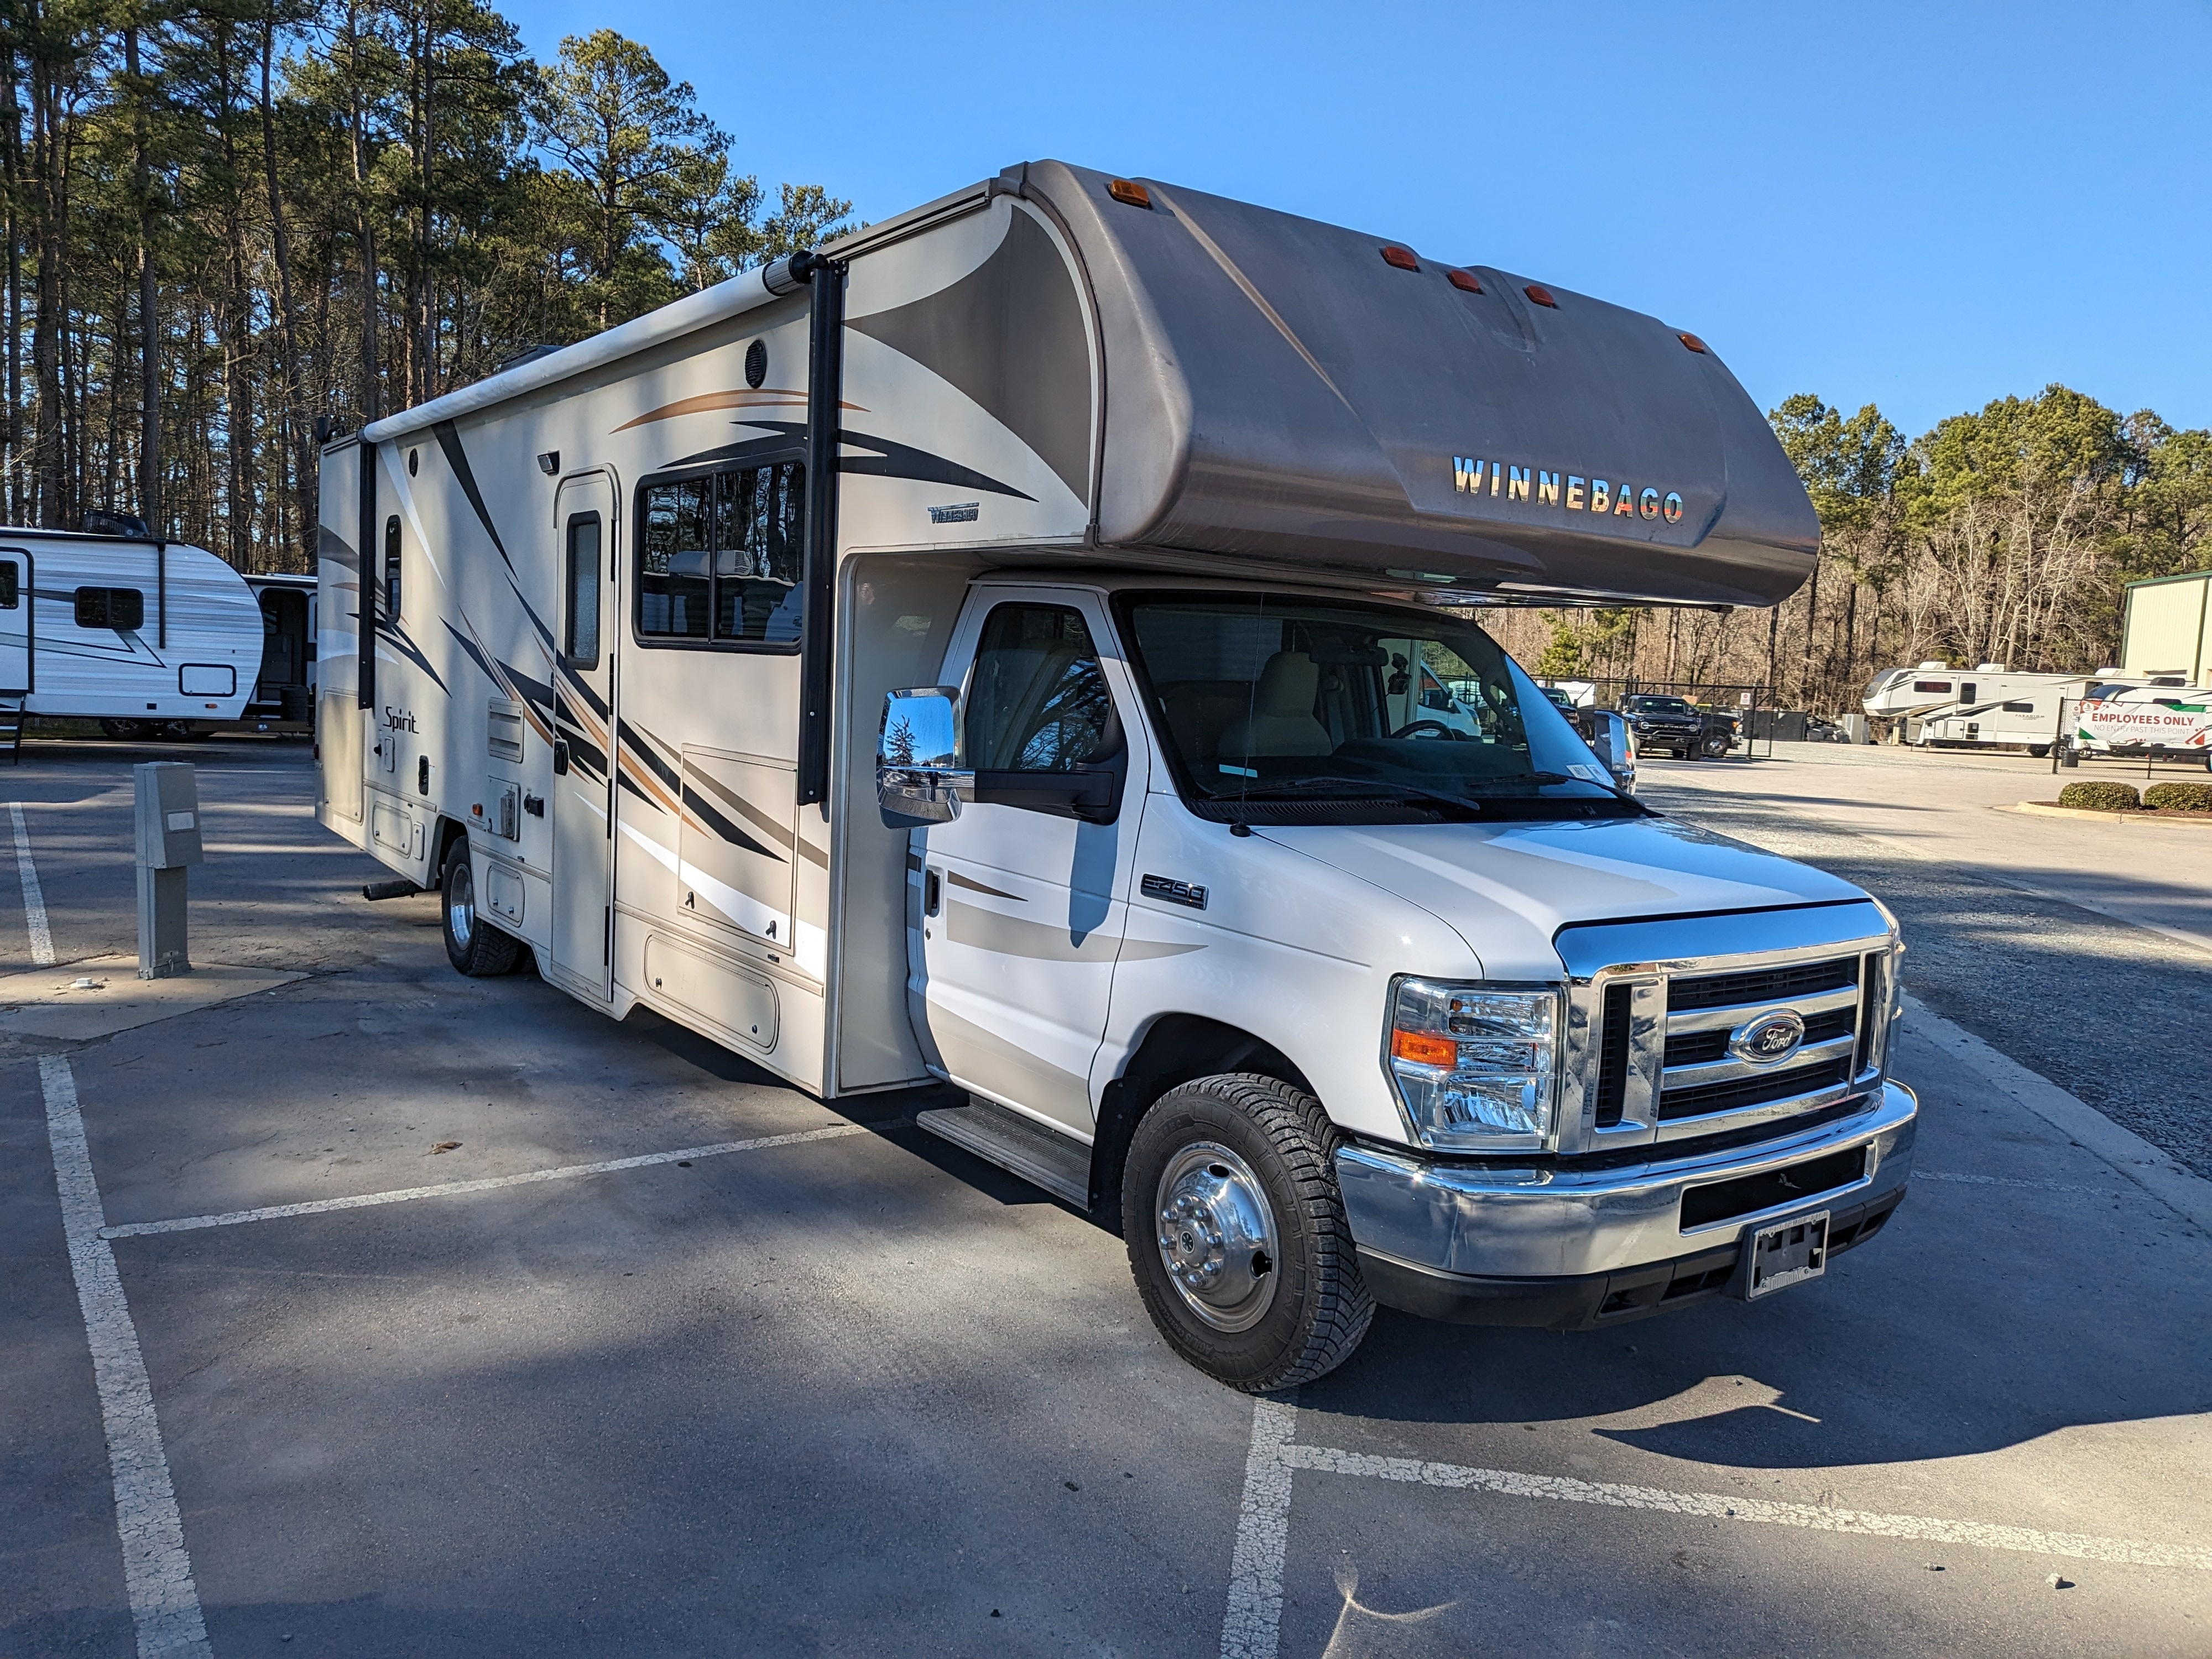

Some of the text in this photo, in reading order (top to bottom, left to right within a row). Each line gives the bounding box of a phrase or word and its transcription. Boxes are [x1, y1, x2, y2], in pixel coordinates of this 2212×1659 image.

[1452, 456, 1683, 524] WINNEBAGO
[383, 706, 419, 734] Spirit
[2091, 713, 2160, 724] EMPLOYEES
[2163, 716, 2195, 726] ONLY
[1762, 1027, 1793, 1051] Ford
